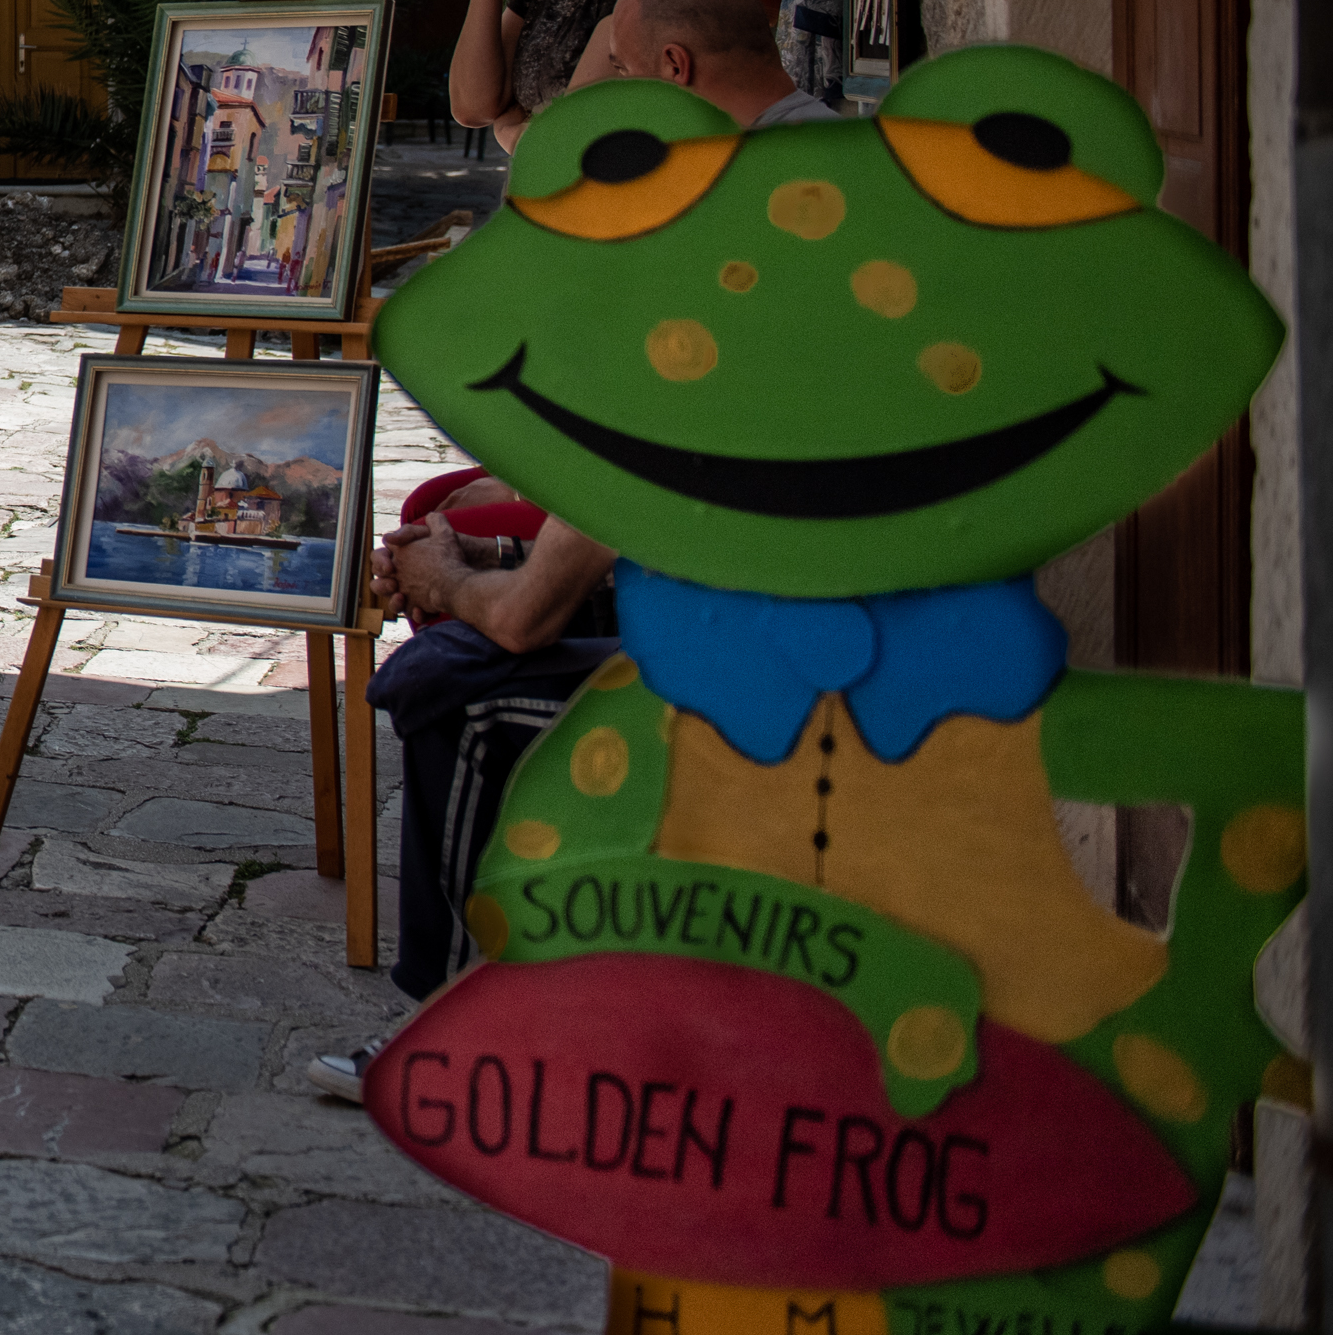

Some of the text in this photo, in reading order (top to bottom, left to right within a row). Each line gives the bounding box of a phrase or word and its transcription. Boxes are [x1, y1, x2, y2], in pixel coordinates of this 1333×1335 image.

[519, 876, 866, 989] SOUVENIRS
[400, 1050, 991, 1240] GOLDEN FROG
